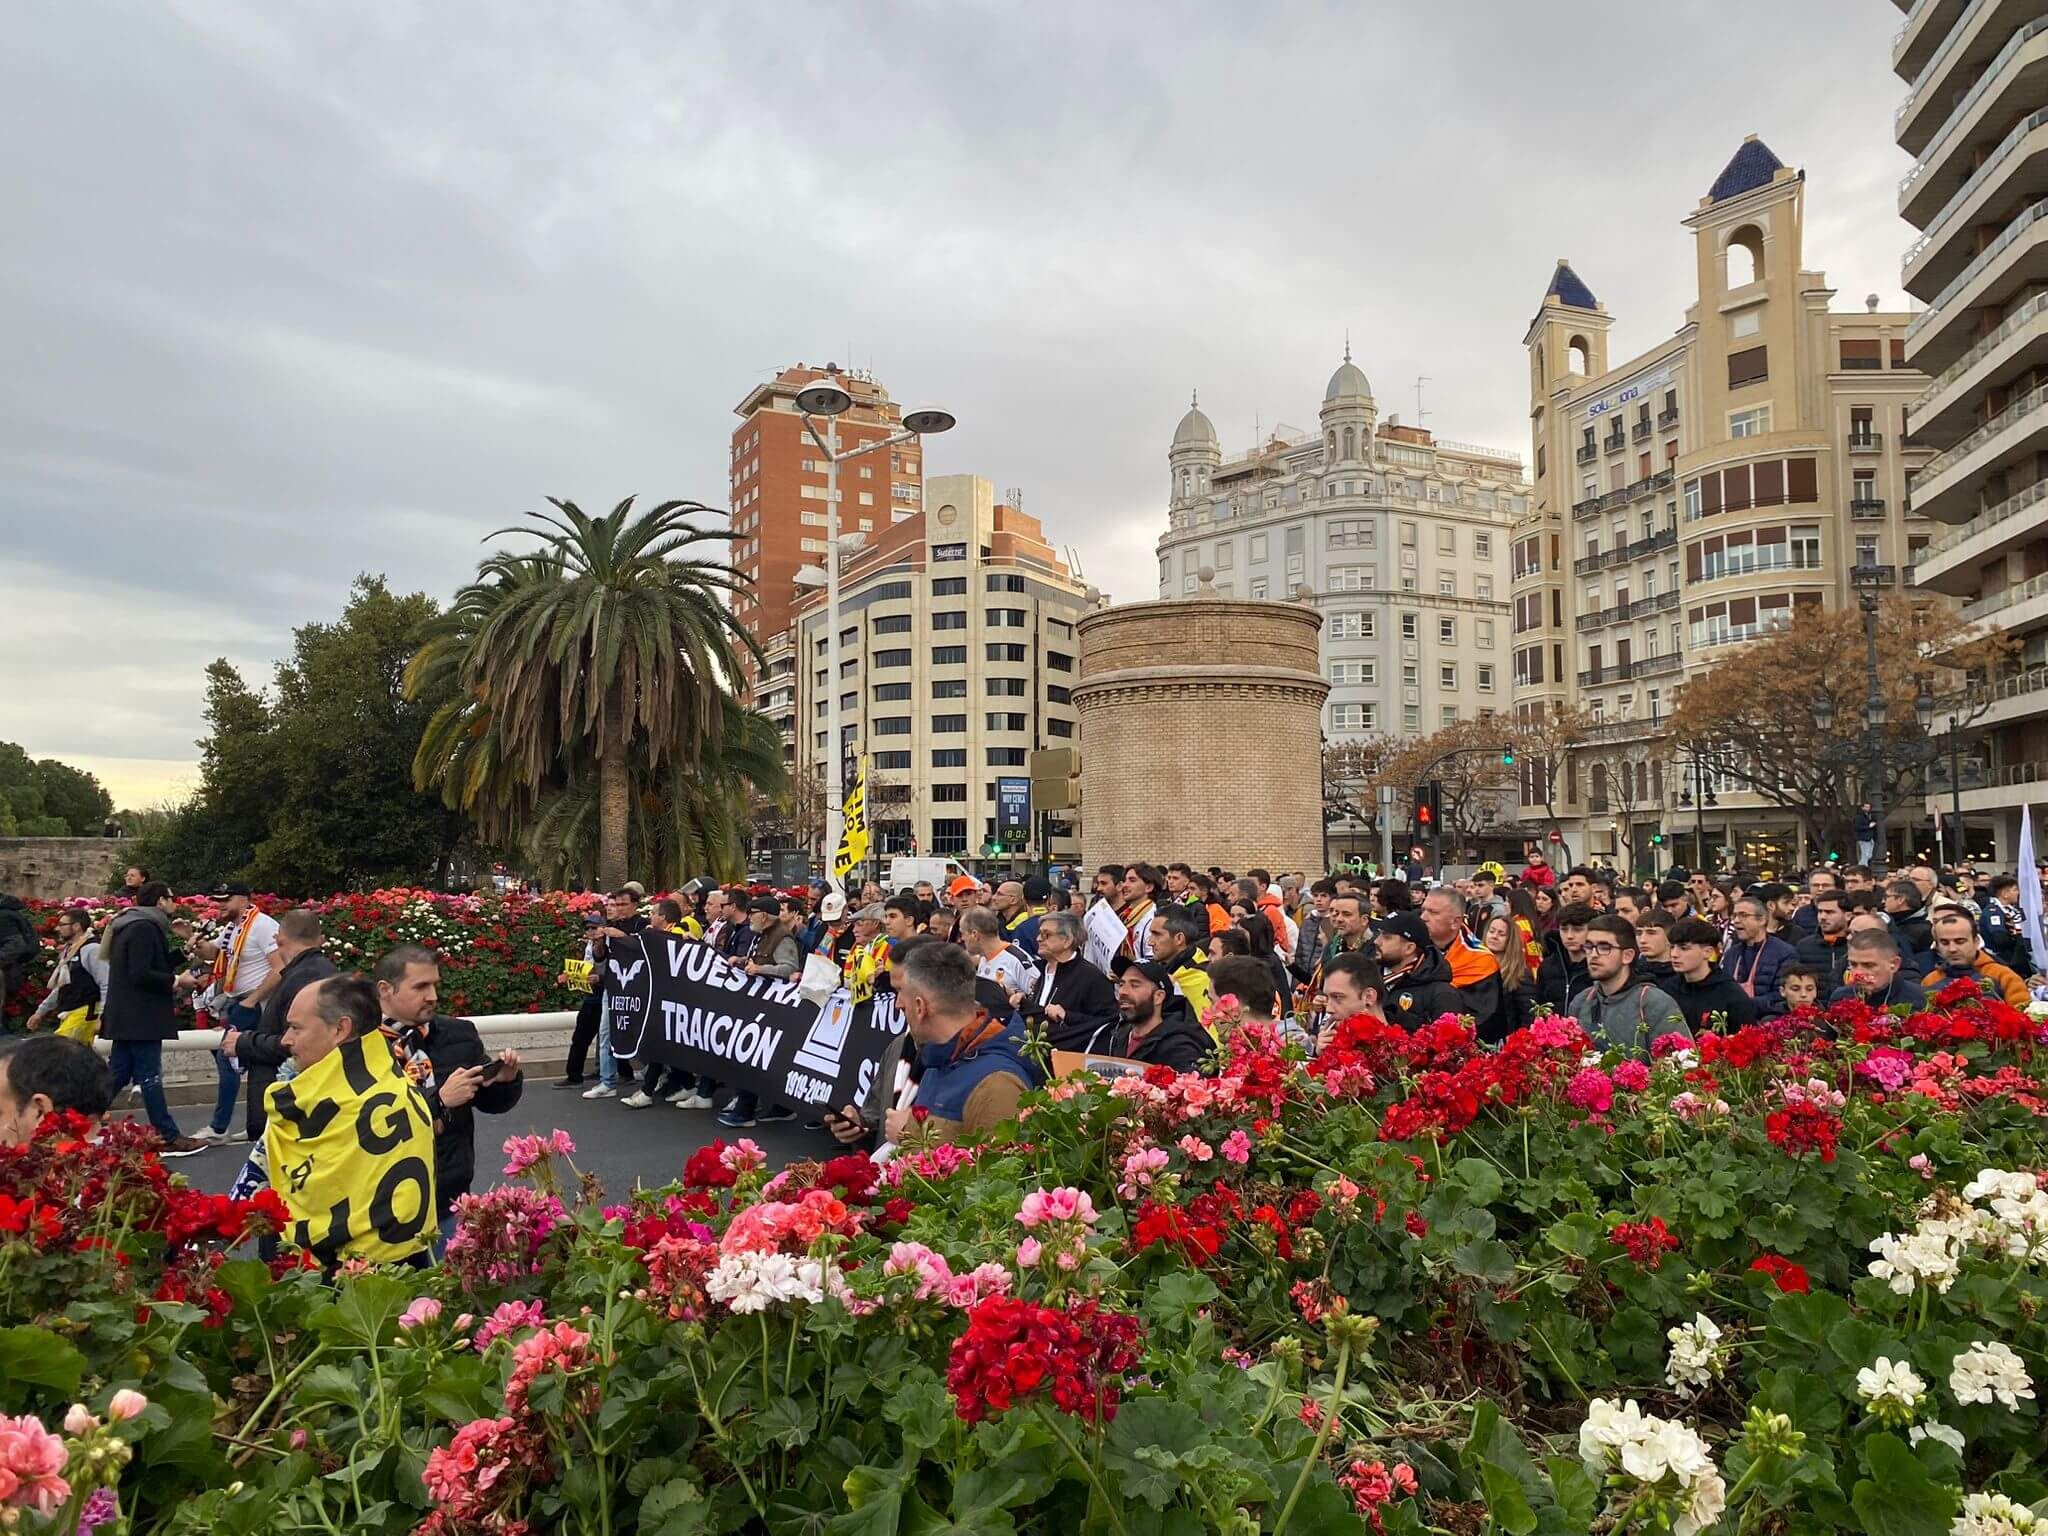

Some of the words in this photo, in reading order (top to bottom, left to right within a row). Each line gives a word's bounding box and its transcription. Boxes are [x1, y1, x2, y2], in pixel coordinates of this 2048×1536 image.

[1004, 830, 1027, 839] 18:02
[667, 939, 802, 1008] VUESTRA
[661, 1001, 783, 1071] TRAICIÓN
